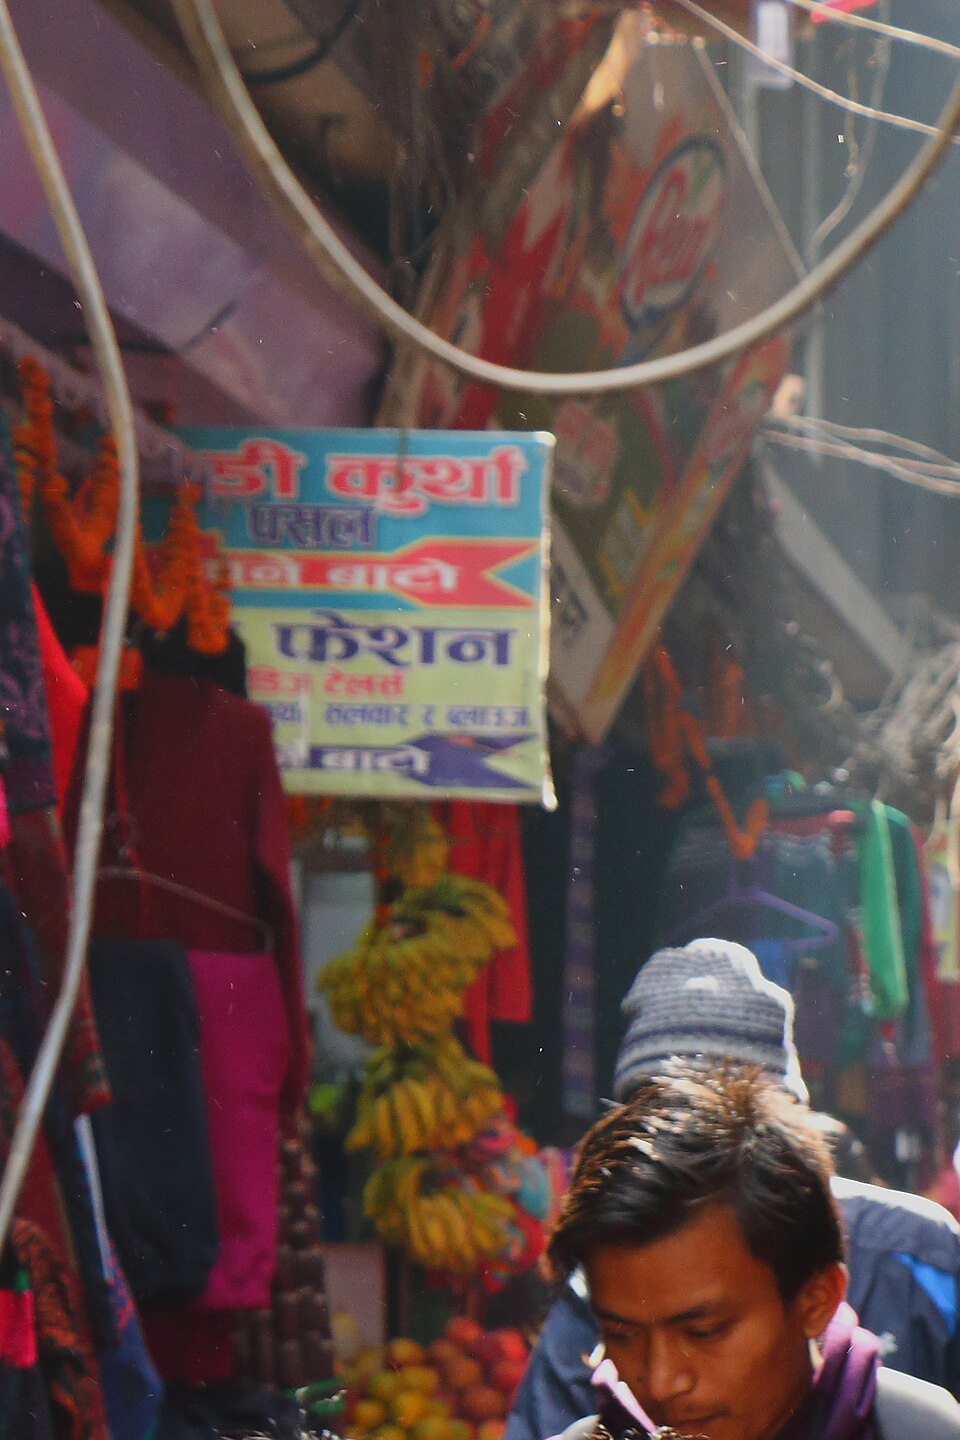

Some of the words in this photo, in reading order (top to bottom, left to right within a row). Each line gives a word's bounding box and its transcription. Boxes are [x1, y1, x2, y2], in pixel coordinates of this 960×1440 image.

[200, 439, 308, 498] डी
[245, 503, 378, 548] पसल
[324, 557, 466, 593] बाटो
